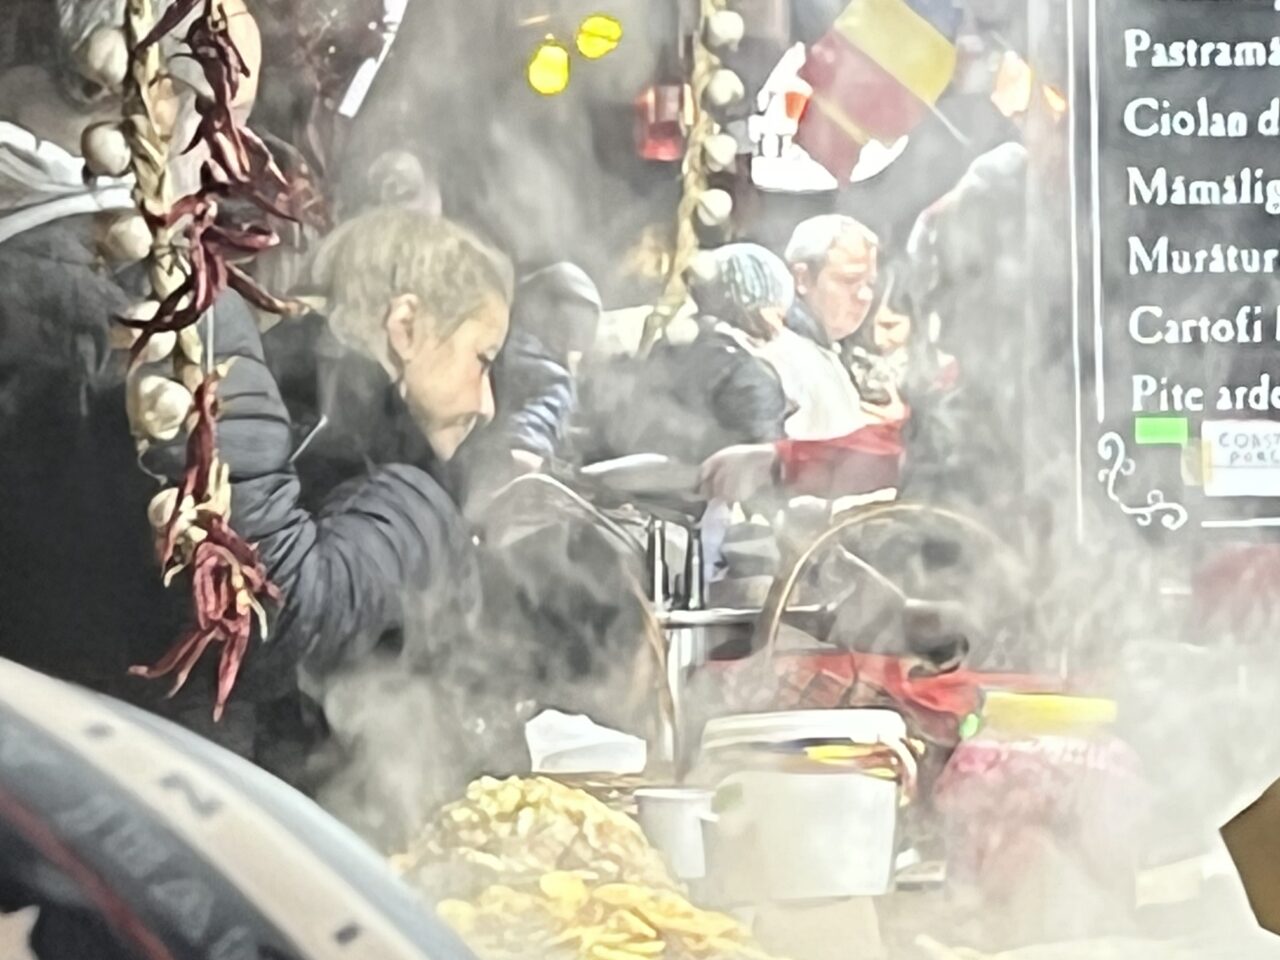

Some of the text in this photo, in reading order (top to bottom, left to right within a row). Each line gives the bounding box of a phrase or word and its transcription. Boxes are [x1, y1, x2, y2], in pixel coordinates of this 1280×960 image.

[1123, 96, 1248, 137] Ciolan
[1128, 304, 1263, 345] Cartofi
[1131, 373, 1205, 412] Pite
